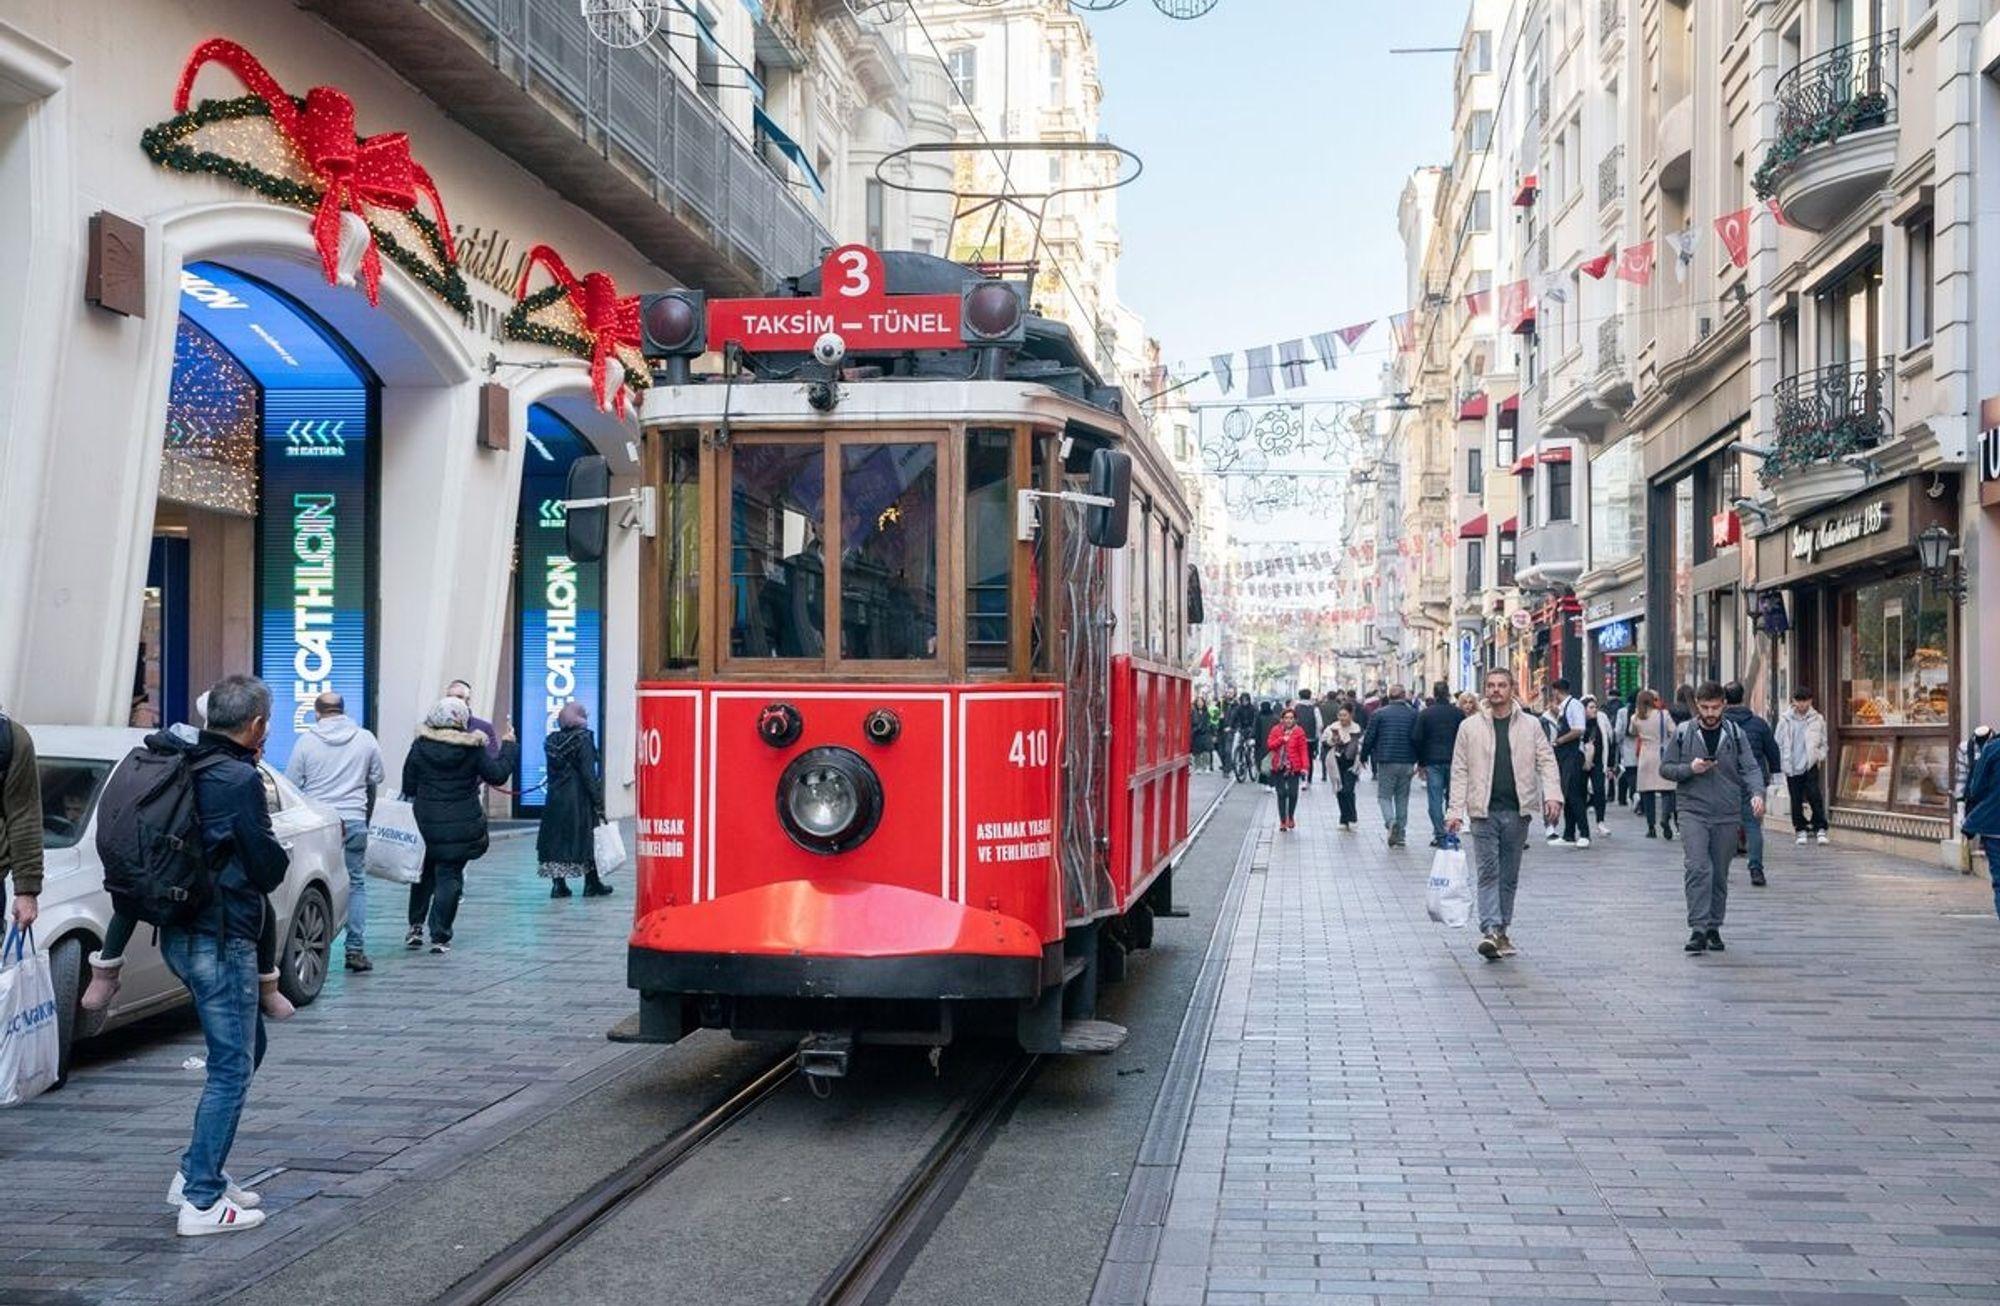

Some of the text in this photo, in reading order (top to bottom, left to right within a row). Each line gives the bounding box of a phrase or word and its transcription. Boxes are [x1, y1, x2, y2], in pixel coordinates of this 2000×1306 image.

[838, 250, 870, 297] 3
[742, 309, 834, 335] TAKSİM
[869, 309, 951, 334] TÜNEL
[1008, 729, 1048, 768] 410
[653, 818, 685, 836] YASAK
[976, 821, 1027, 841] ASILMAK
[977, 844, 993, 863] VE
